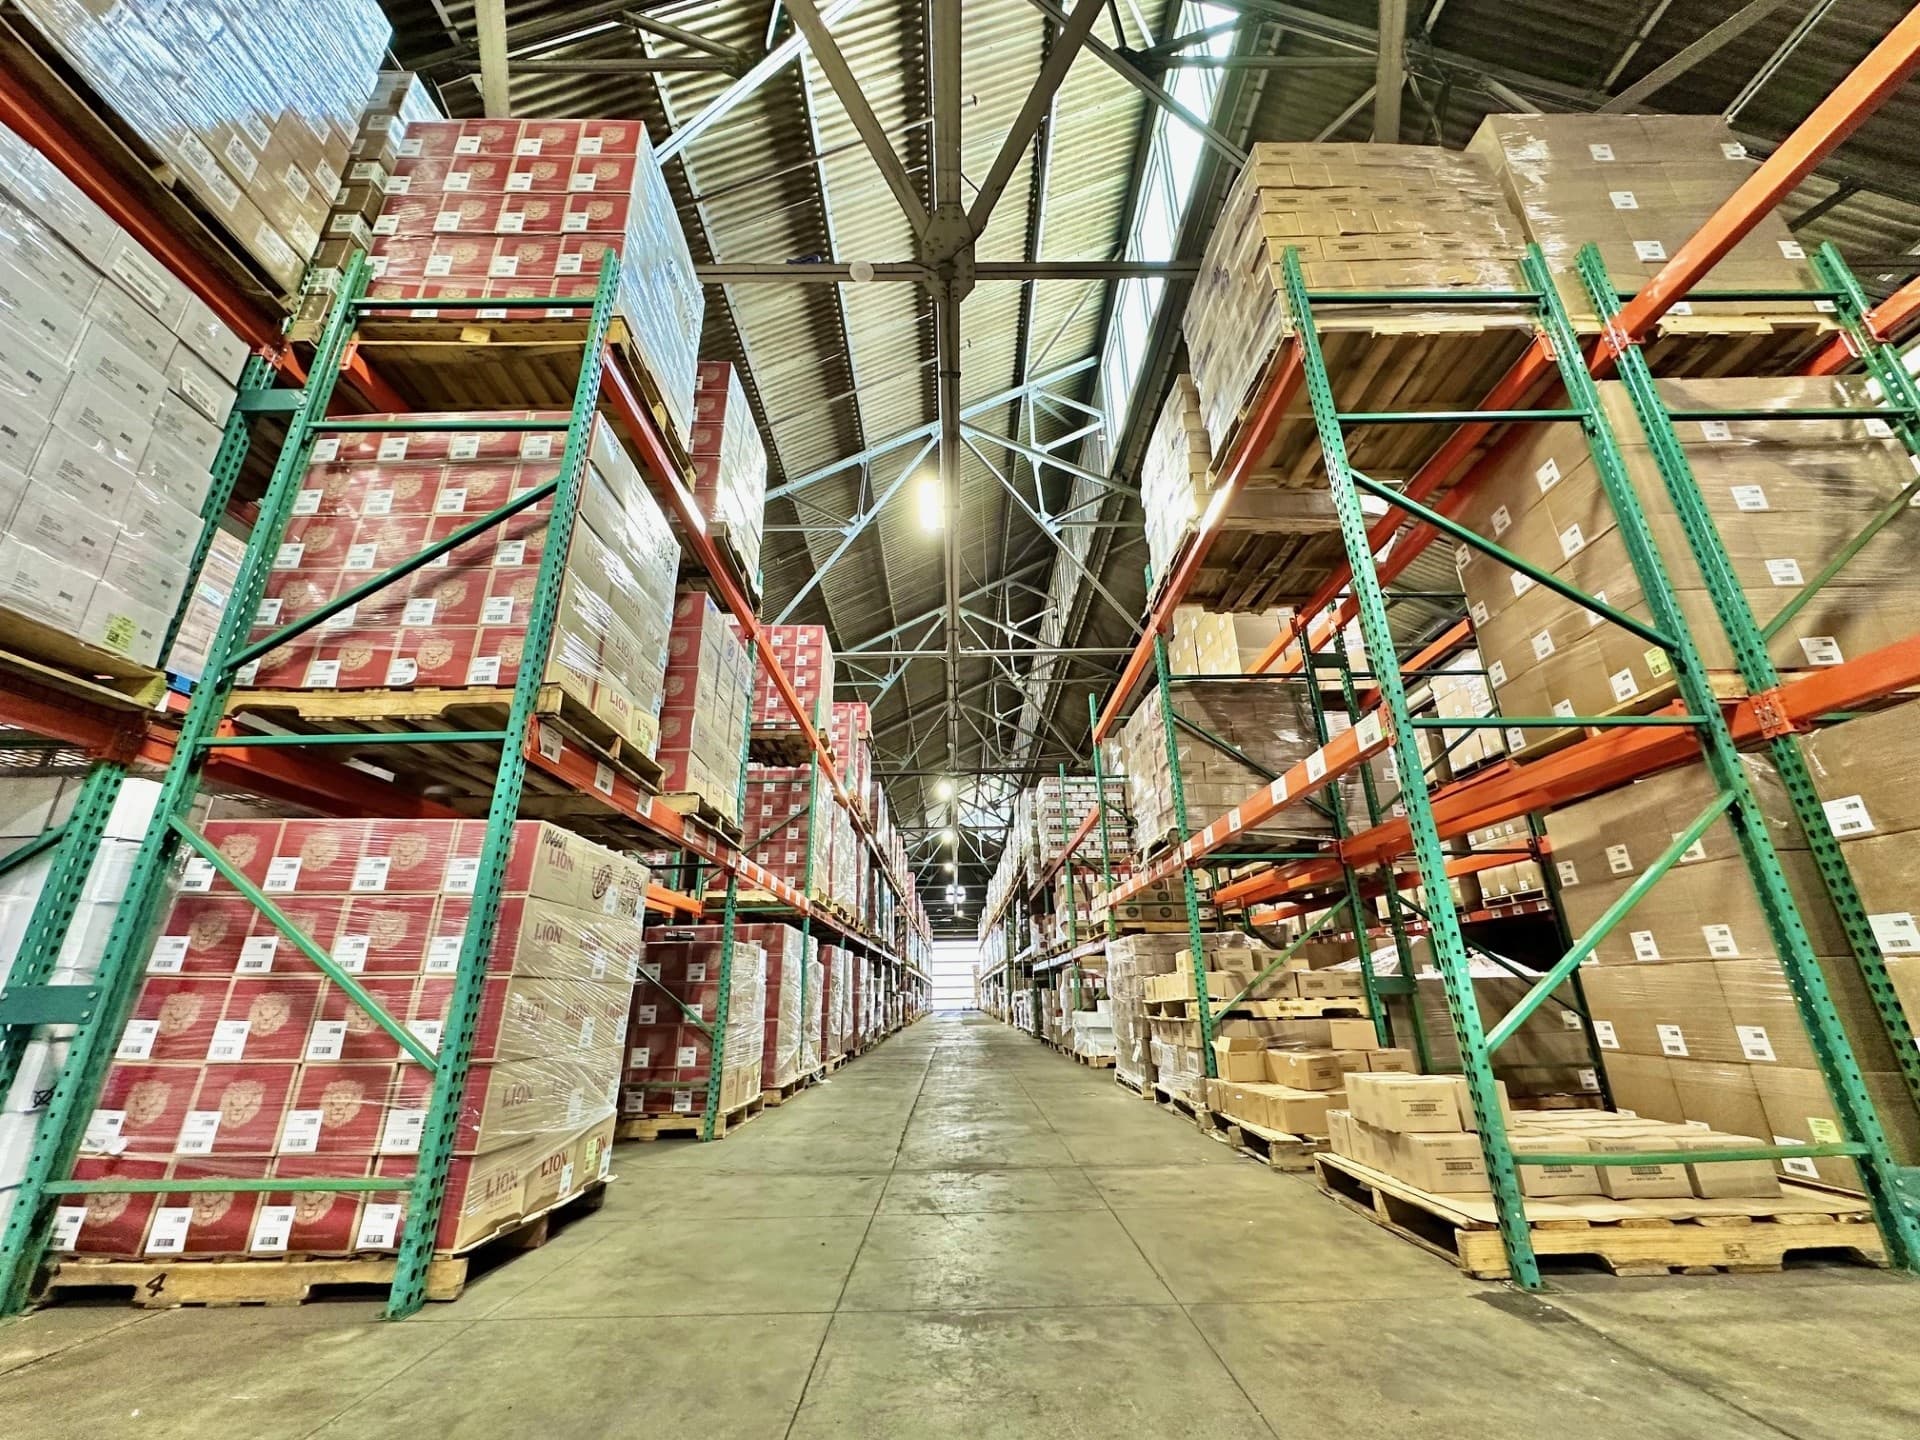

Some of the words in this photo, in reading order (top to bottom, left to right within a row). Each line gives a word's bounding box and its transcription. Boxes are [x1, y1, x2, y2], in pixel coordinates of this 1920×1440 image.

[609, 689, 629, 717] LION
[549, 848, 575, 873] LION
[534, 923, 563, 945] LION
[541, 1151, 568, 1178] LION
[486, 1168, 518, 1199] LION
[145, 1272, 168, 1298] 4
